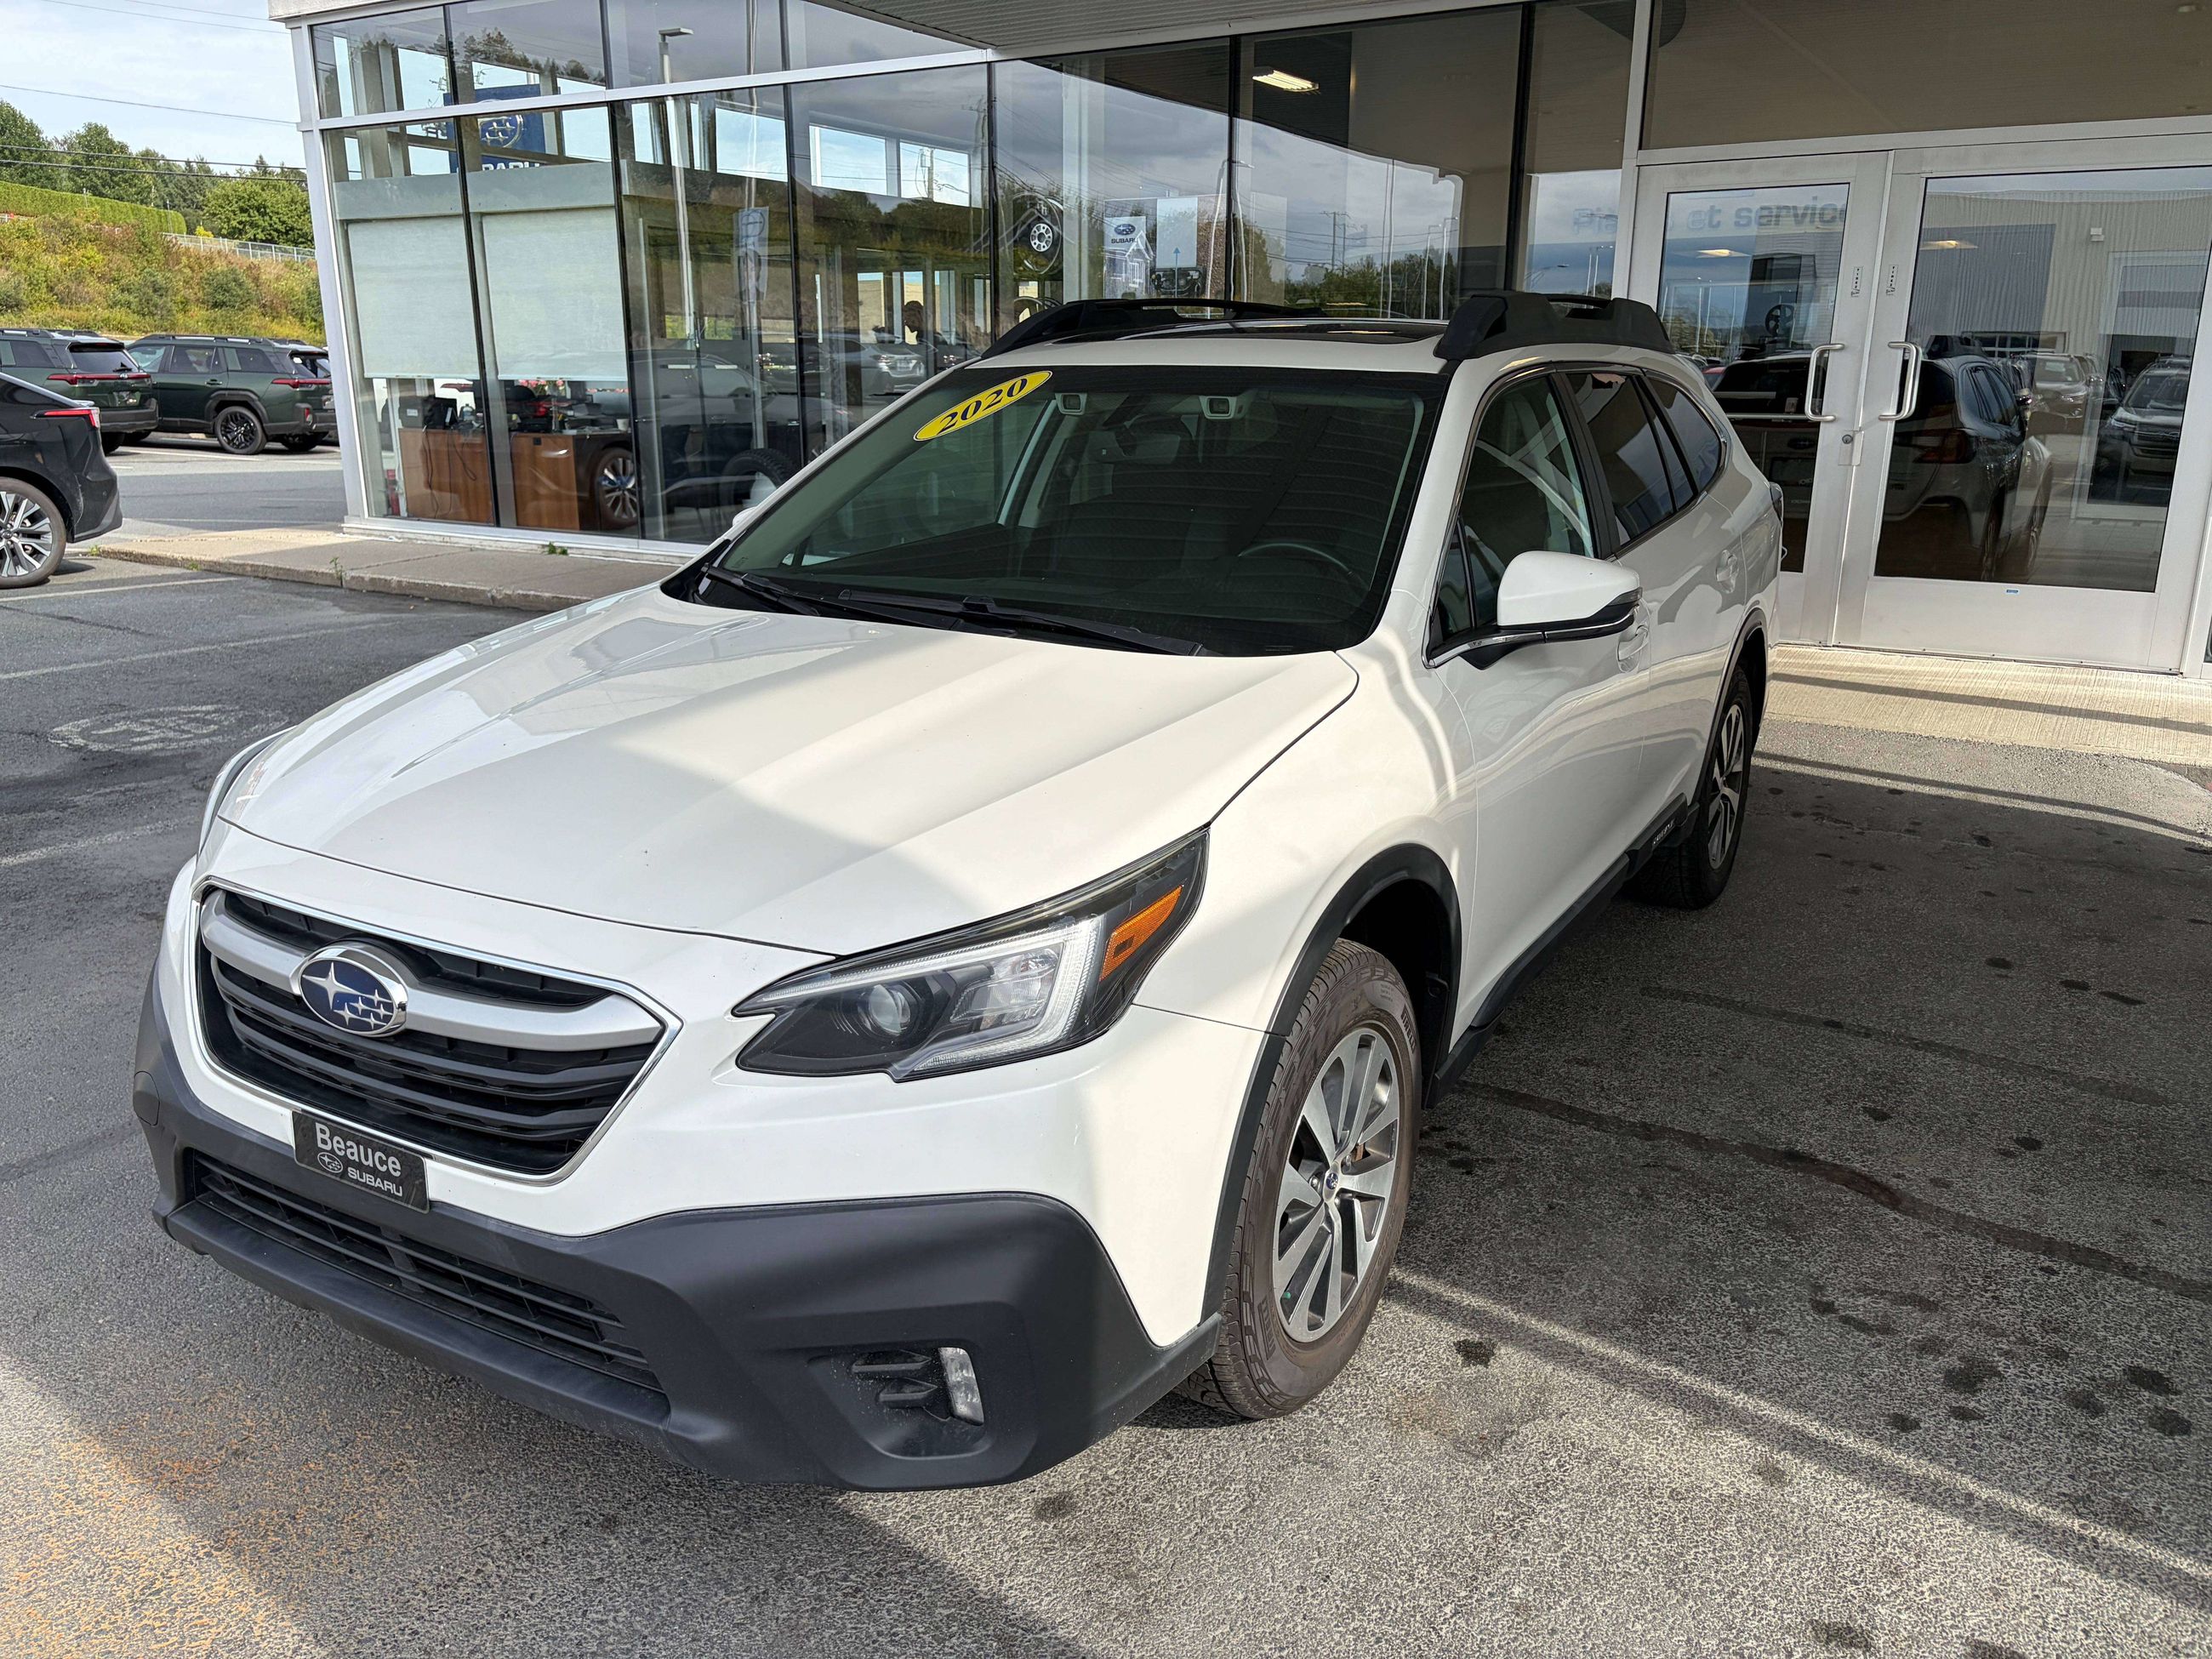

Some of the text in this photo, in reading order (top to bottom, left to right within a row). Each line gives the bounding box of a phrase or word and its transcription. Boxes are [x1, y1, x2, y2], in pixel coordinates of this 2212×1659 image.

[1687, 205, 1721, 230] et
[936, 378, 1028, 436] 2020
[315, 1122, 402, 1177] Beauce
[347, 1166, 403, 1197] SUBARU
